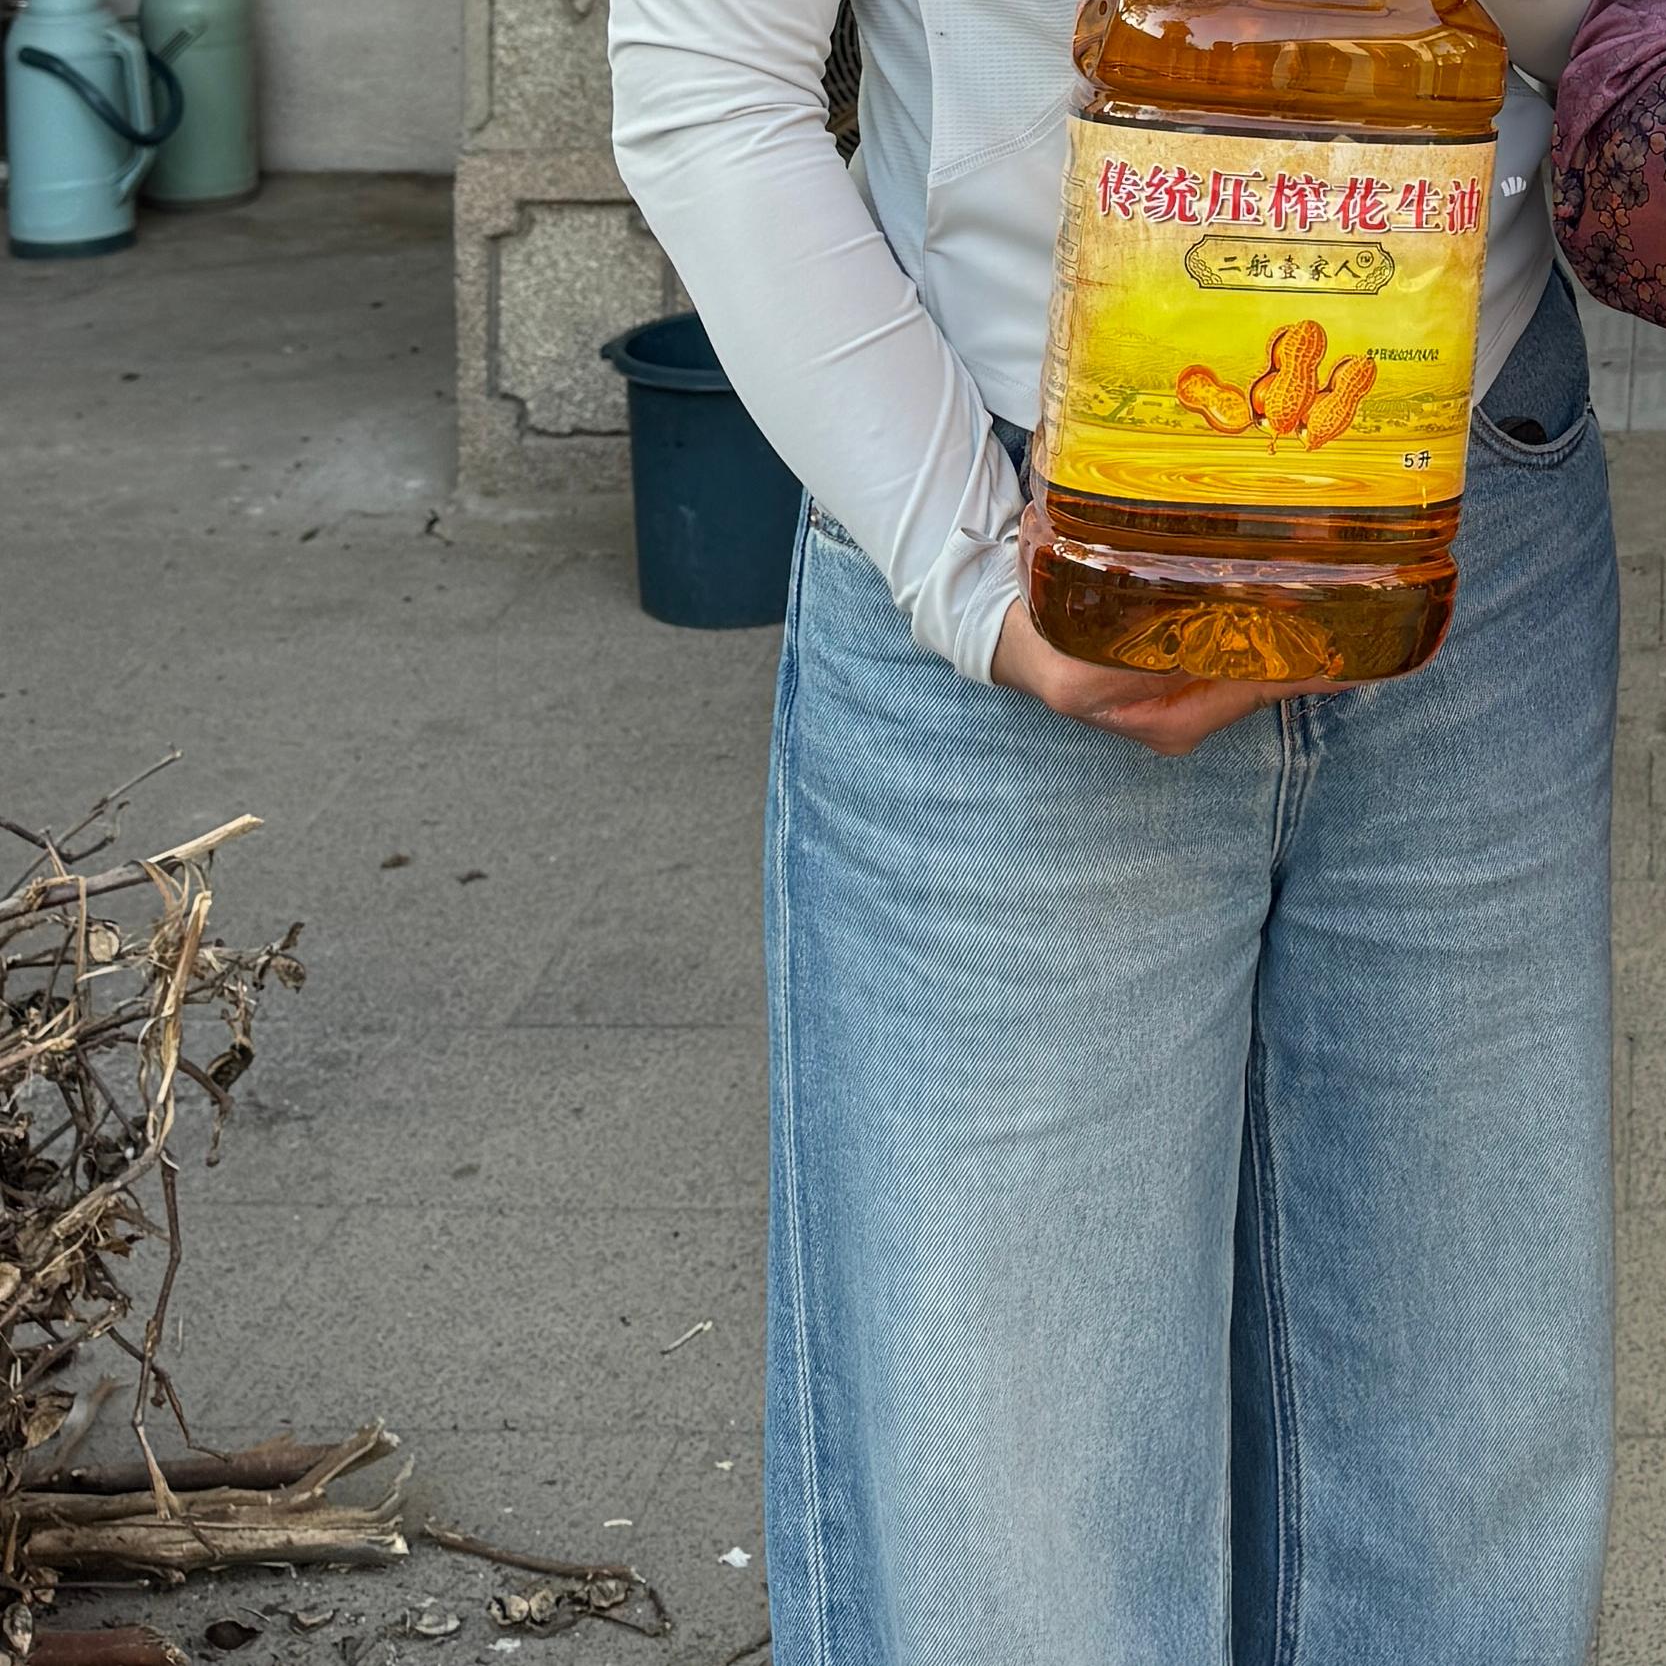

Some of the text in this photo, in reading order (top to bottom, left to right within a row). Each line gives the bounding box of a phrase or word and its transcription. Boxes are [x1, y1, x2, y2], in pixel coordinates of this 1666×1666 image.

[1097, 157, 1482, 234] 传统压榨花生油
[1217, 253, 1361, 282] 二航壹家人
[1404, 450, 1432, 469] 5升
